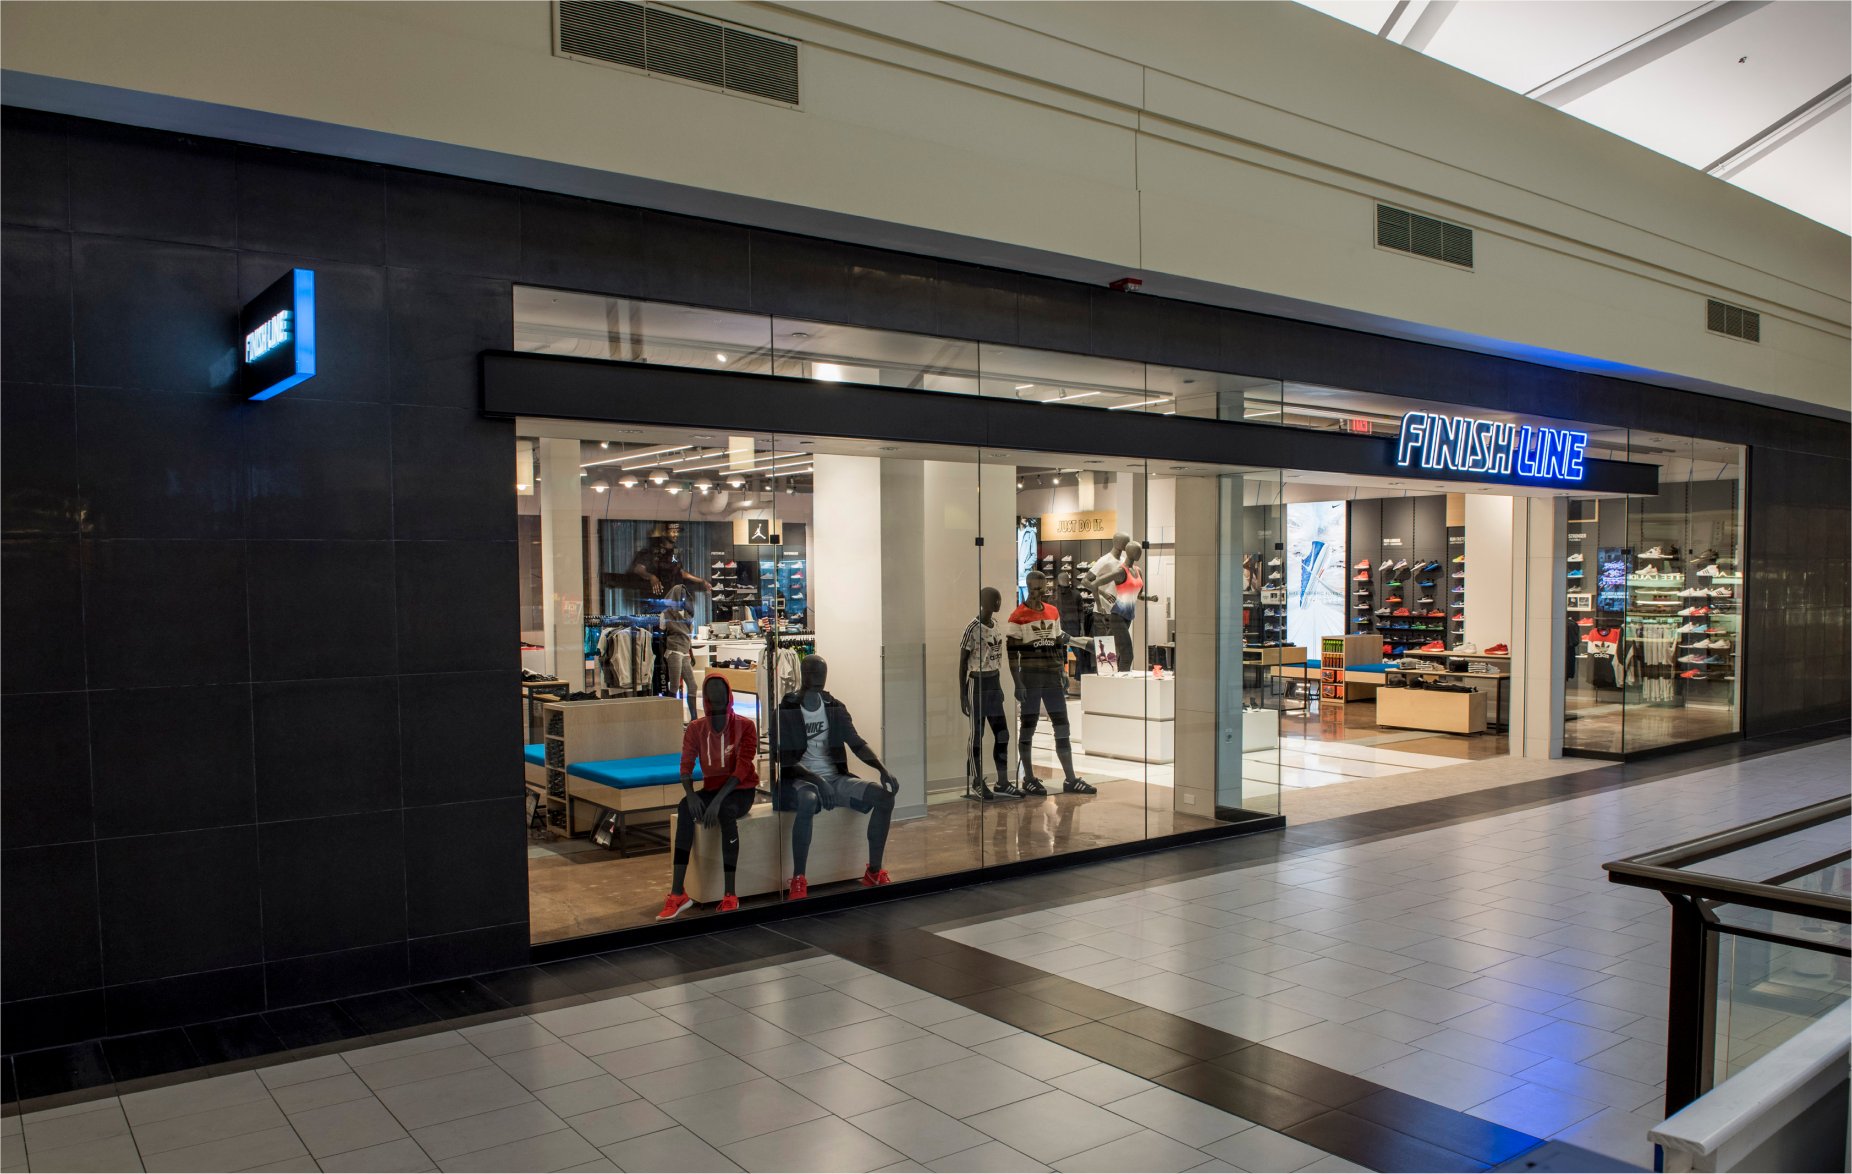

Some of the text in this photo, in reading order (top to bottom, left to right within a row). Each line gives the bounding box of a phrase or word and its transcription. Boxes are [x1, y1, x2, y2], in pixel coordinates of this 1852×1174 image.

[245, 310, 288, 363] FINISH LINE
[1397, 410, 1588, 480] FINISH LINE
[1057, 520, 1077, 532] JUST
[1078, 519, 1092, 532] DO
[1033, 638, 1055, 648] adidas
[805, 721, 825, 734] NIKE
